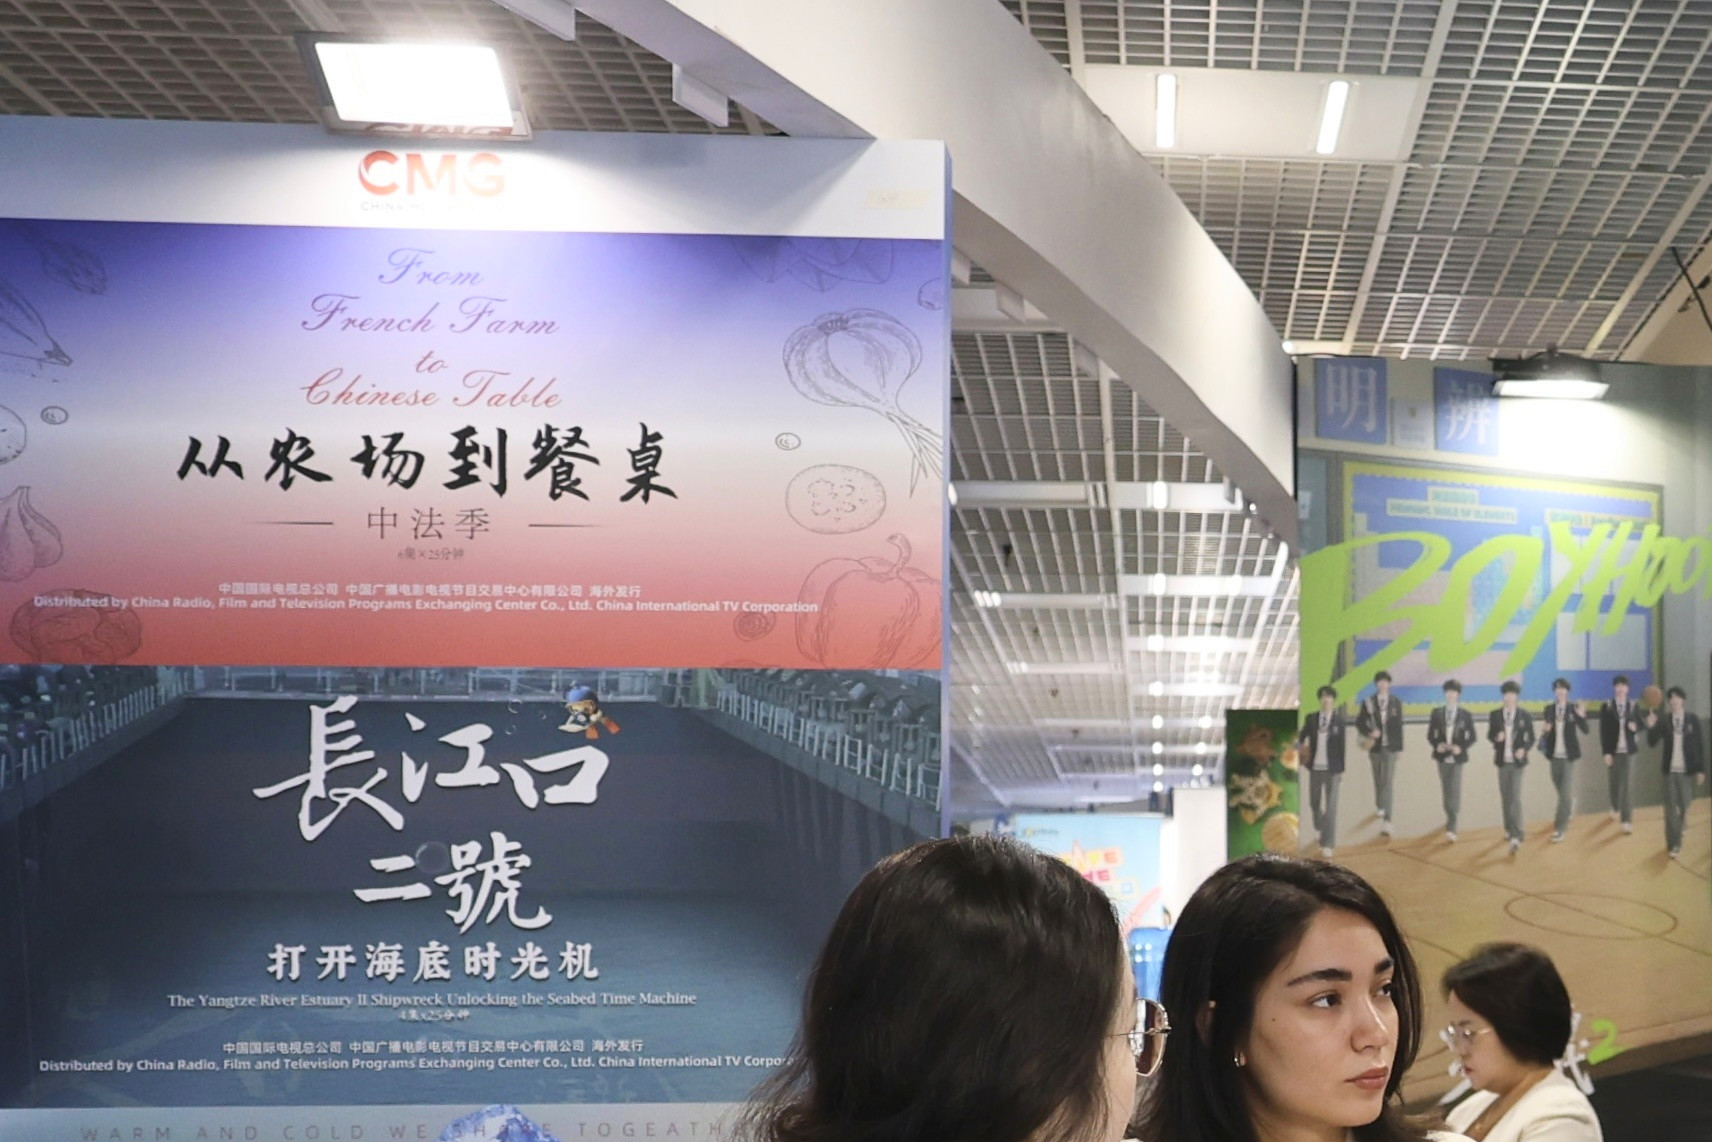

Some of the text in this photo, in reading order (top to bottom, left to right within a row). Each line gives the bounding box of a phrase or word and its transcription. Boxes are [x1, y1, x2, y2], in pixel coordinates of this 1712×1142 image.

[358, 150, 506, 197] CMG
[378, 248, 485, 285] From
[301, 293, 560, 334] French Farm
[415, 350, 448, 374] to
[300, 368, 562, 408] Chinese Table
[176, 422, 679, 505] 从农场到餐桌
[366, 506, 491, 541] 中法季
[33, 595, 819, 614] Distributed by China Radio, Film and Television Programs Exchanging Center Co., Ltd. China International TV Corporation
[252, 694, 611, 842] 長江口
[353, 831, 553, 935] 二號
[267, 940, 600, 984] 打开海底时光机
[167, 994, 195, 1007] The
[198, 994, 256, 1010] Yangtze
[259, 993, 298, 1007] River
[300, 994, 352, 1010] Estuary
[370, 992, 442, 1009] Shipwreck
[447, 992, 518, 1008] Unlocking
[522, 992, 544, 1005] the
[547, 992, 597, 1005] Seabed
[600, 993, 636, 1006] Time
[639, 993, 698, 1005] Machine
[39, 1059, 114, 1072] Distributed
[117, 1059, 132, 1073] by
[136, 1060, 174, 1071] China
[177, 1060, 220, 1073] Radio,
[223, 1059, 251, 1070] Film
[254, 1059, 280, 1070] and
[283, 1057, 349, 1070] Television
[352, 1057, 415, 1072] Programs
[418, 1056, 495, 1071] Exchanging
[498, 1056, 540, 1069] Center
[542, 1056, 568, 1069] Co.,
[570, 1056, 595, 1068] Ltd.
[598, 1056, 635, 1068] China
[638, 1055, 722, 1068] International
[724, 1055, 741, 1067] TV
[222, 1041, 341, 1055] 中国国际电视总公司
[591, 1039, 644, 1053] 海外发行
[80, 1126, 170, 1142] WARM
[195, 1126, 258, 1142] AND
[282, 1125, 364, 1142] COLD
[388, 1124, 428, 1140] WE
